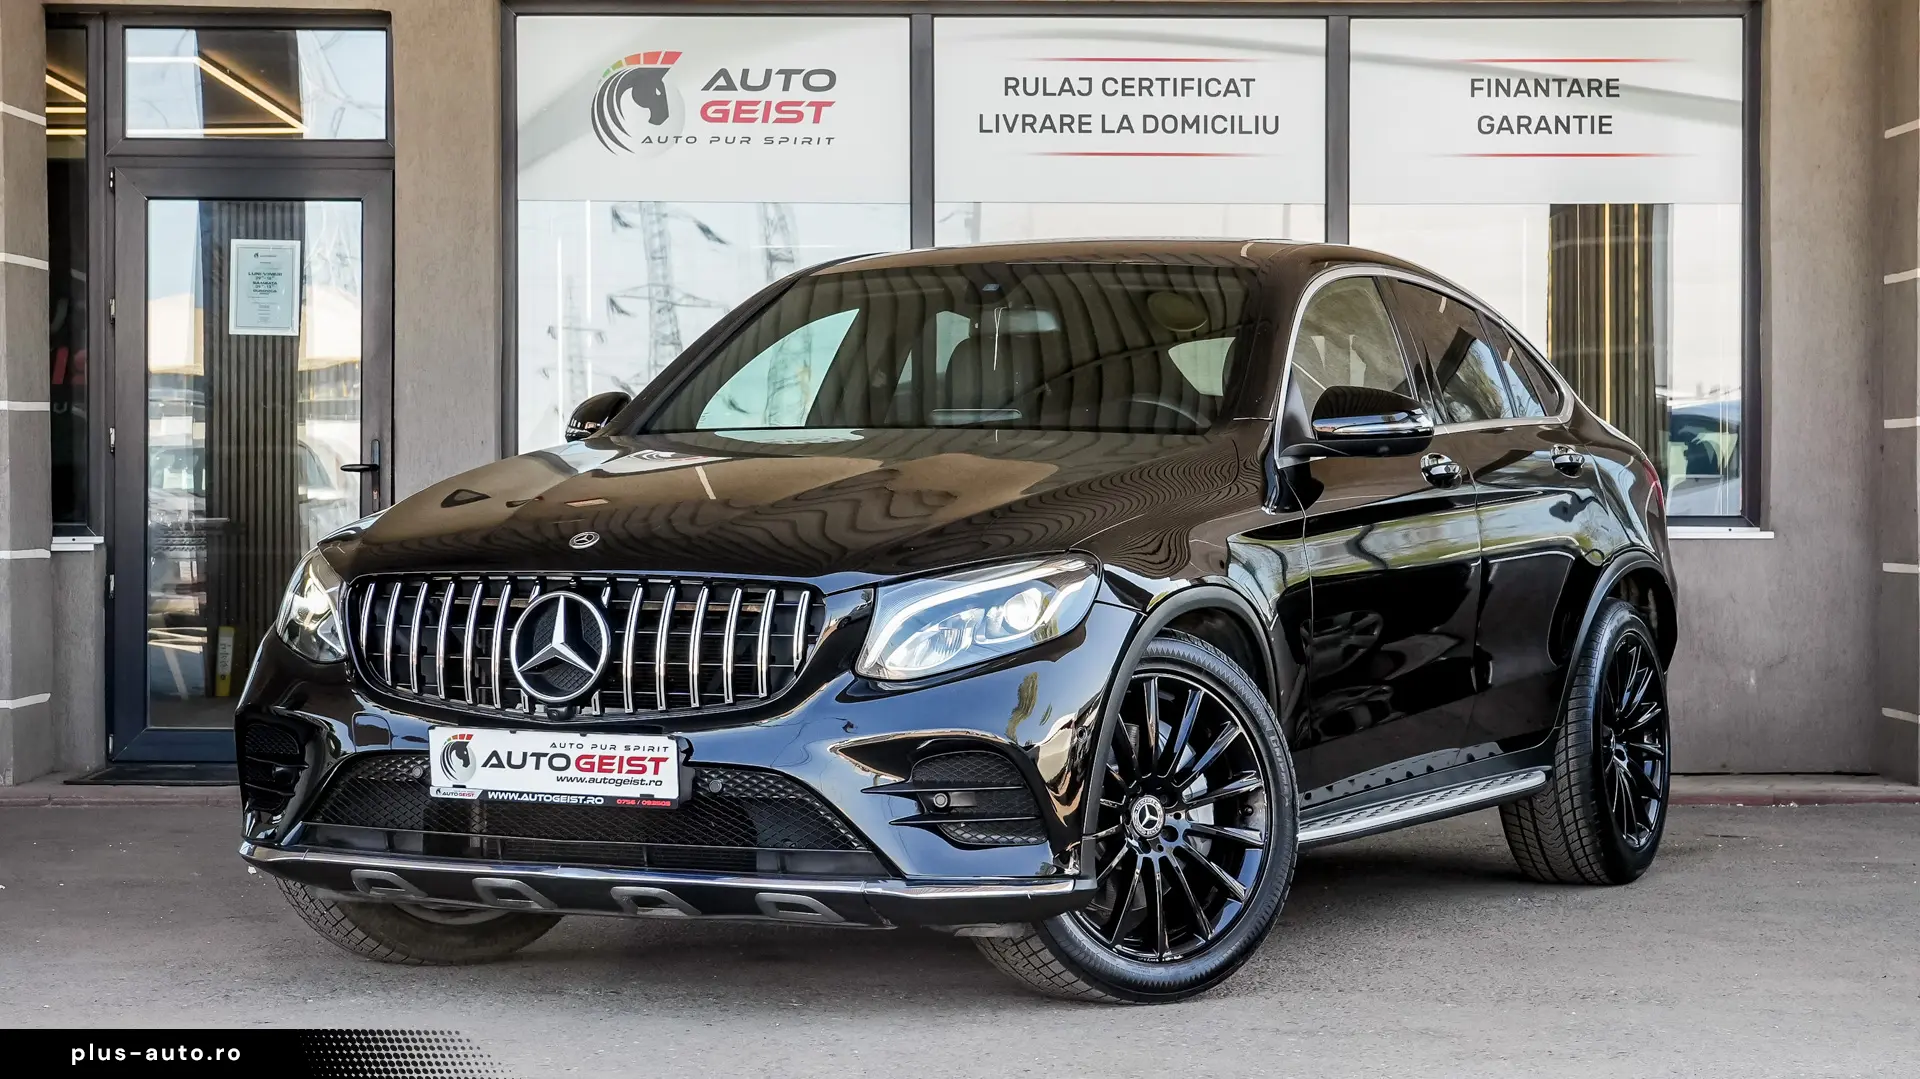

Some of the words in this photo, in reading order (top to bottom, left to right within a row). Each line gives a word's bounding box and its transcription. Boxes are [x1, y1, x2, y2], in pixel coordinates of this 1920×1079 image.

[700, 67, 837, 92] AUTO
[1003, 76, 1093, 97] RULAJ
[1101, 77, 1256, 98] CERTIFICAT
[1470, 77, 1620, 98] FINANTARE
[699, 100, 836, 124] GEIST
[978, 113, 1093, 134] LIVRARE
[1100, 114, 1135, 134] LA
[1142, 114, 1280, 135] DOMICILIU
[1477, 115, 1613, 135] GARANTIE
[641, 135, 698, 145] AUTO
[709, 136, 752, 145] PUR
[763, 136, 835, 146] SPIRIT
[549, 742, 584, 750] AUTO
[591, 743, 617, 751] PUR
[624, 744, 669, 753] SPIRIT
[556, 775, 663, 787] www.autogeist.ro
[487, 791, 604, 805] WWW.AUTOGEIST.RO
